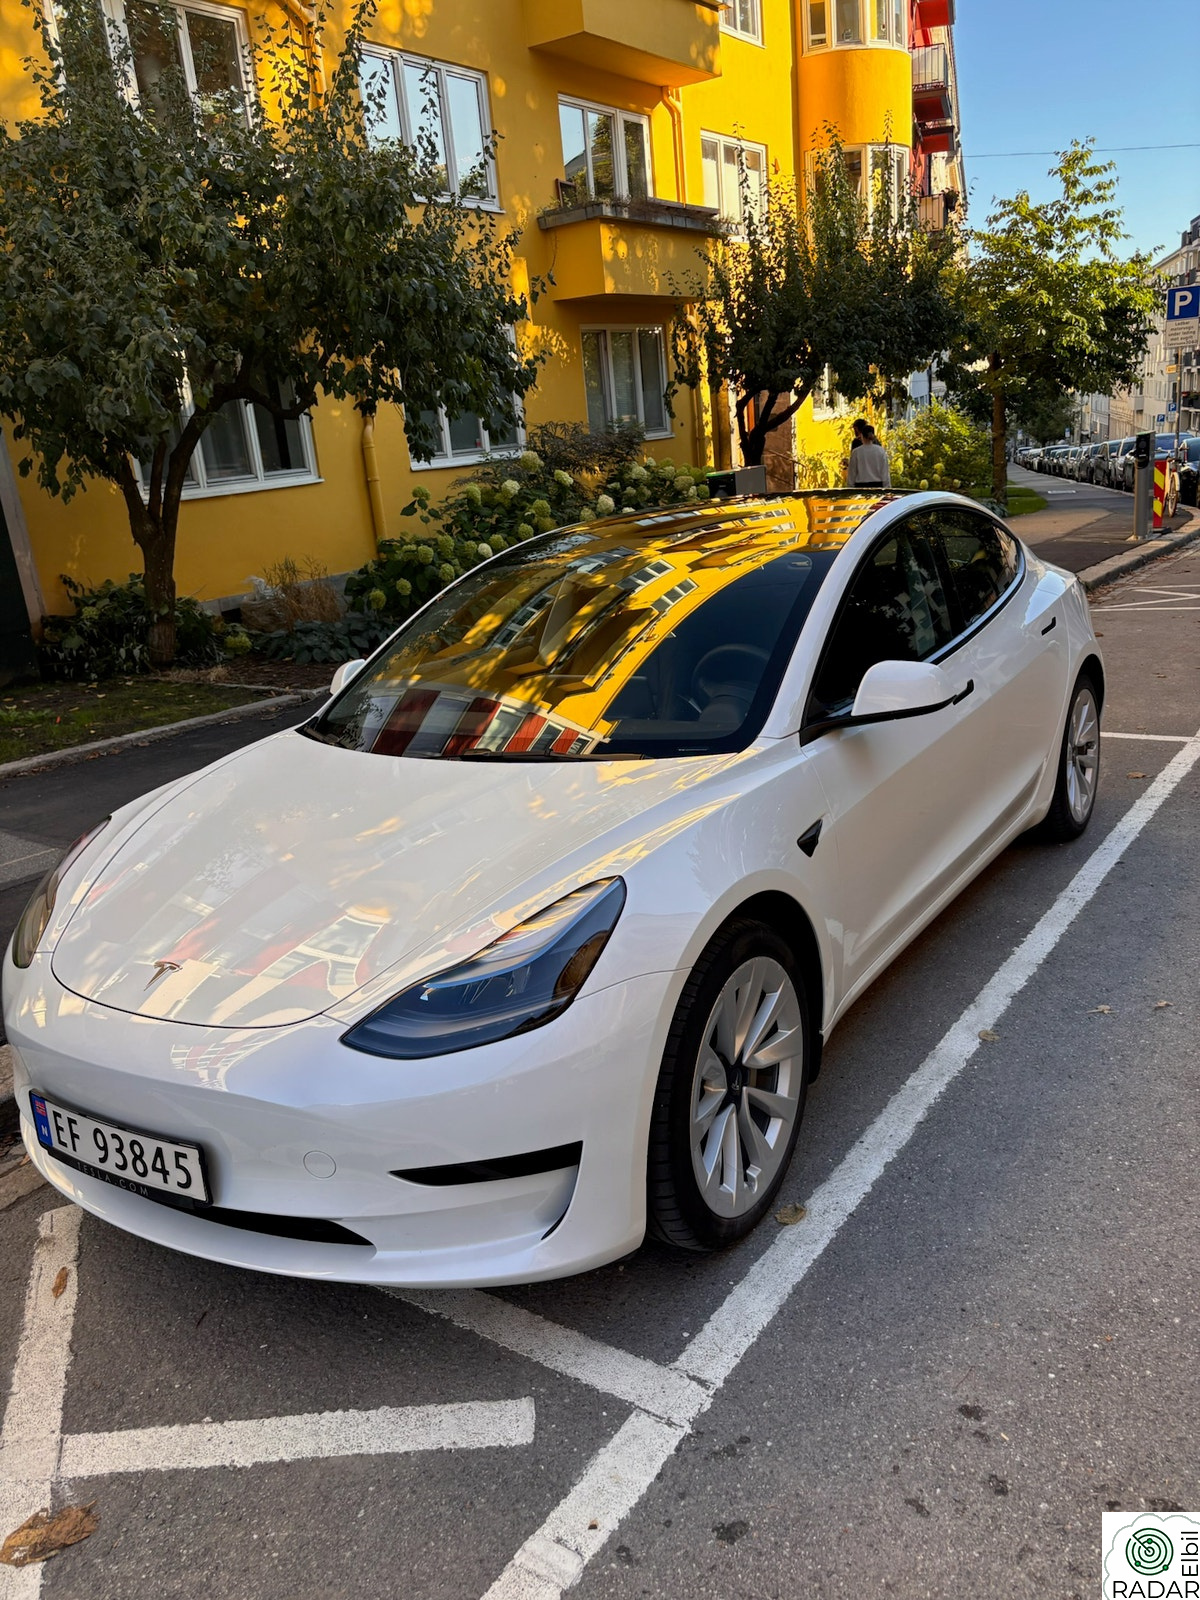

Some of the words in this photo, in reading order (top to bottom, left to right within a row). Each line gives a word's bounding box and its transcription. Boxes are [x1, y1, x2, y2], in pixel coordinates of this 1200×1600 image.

[1174, 290, 1193, 316] P
[41, 1124, 49, 1136] N
[52, 1110, 80, 1152] EF
[93, 1127, 193, 1190] 93845
[76, 1161, 150, 1197] TESLA.COM
